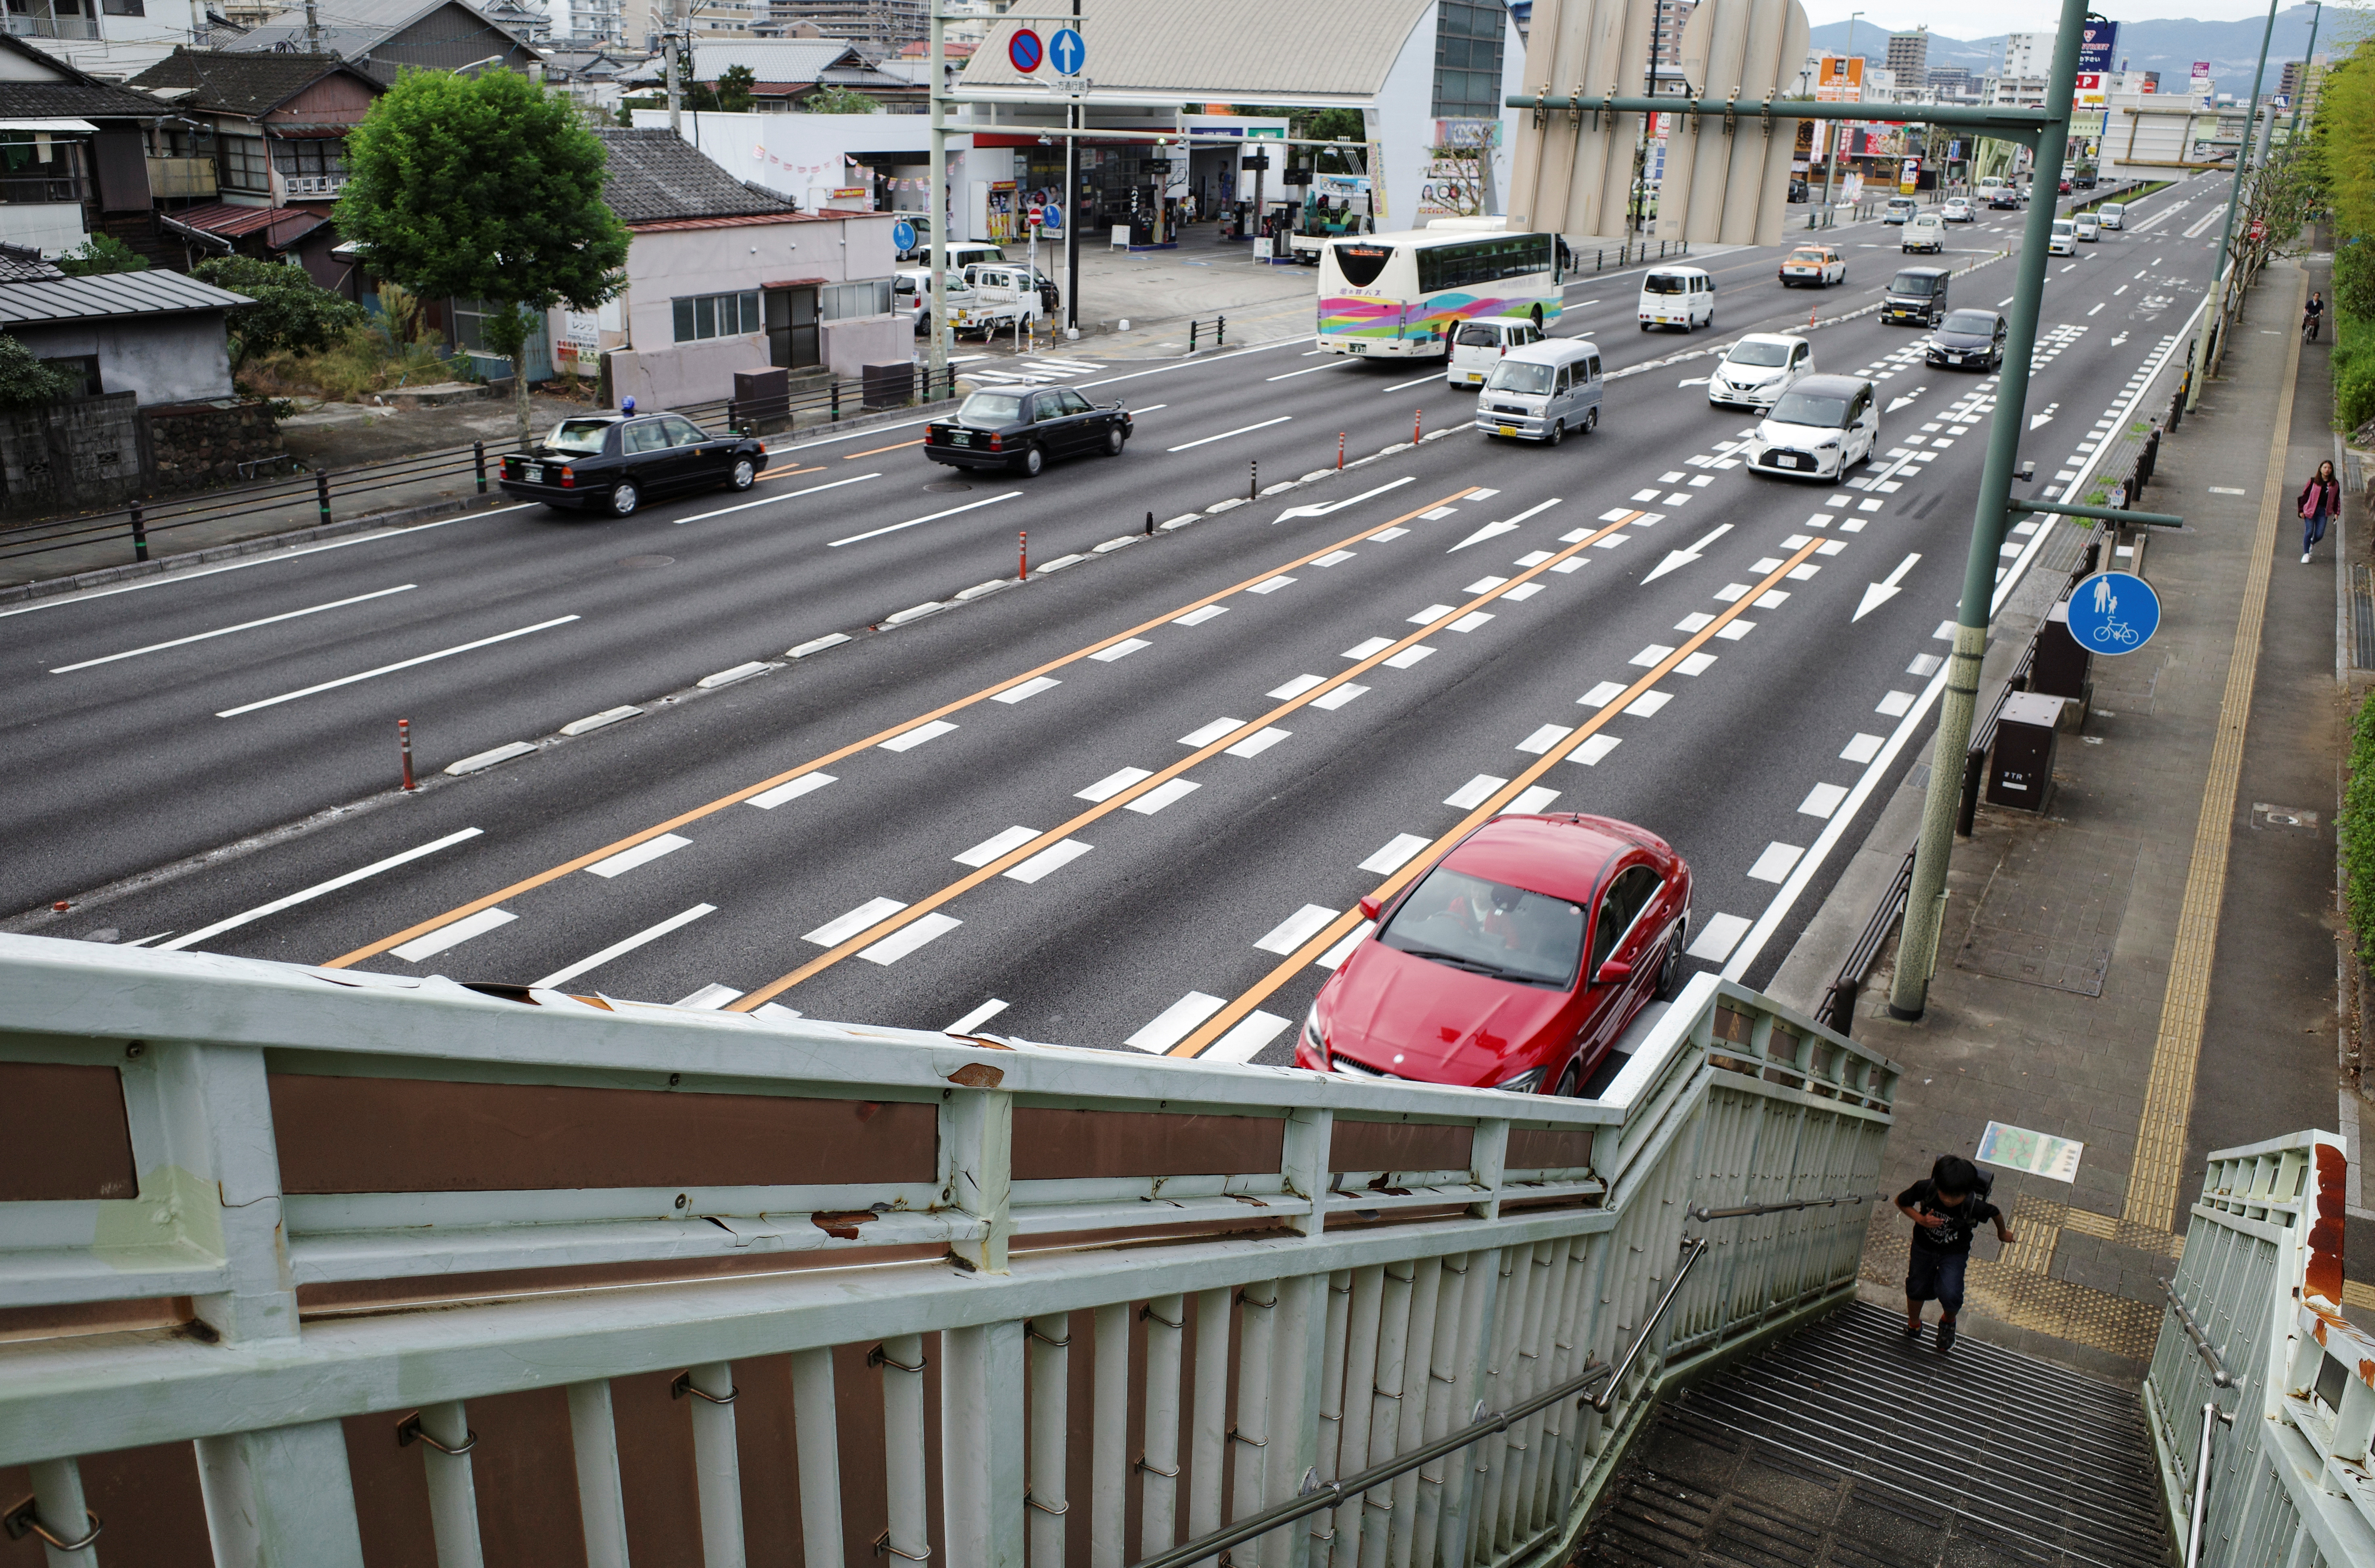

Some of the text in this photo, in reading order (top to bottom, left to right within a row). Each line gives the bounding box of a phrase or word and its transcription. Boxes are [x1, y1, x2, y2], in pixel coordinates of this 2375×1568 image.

[1051, 81, 1085, 91] 一方通行路
[2082, 77, 2092, 87] P
[1903, 160, 1917, 171] P
[1339, 287, 1381, 296] 亀の井バス
